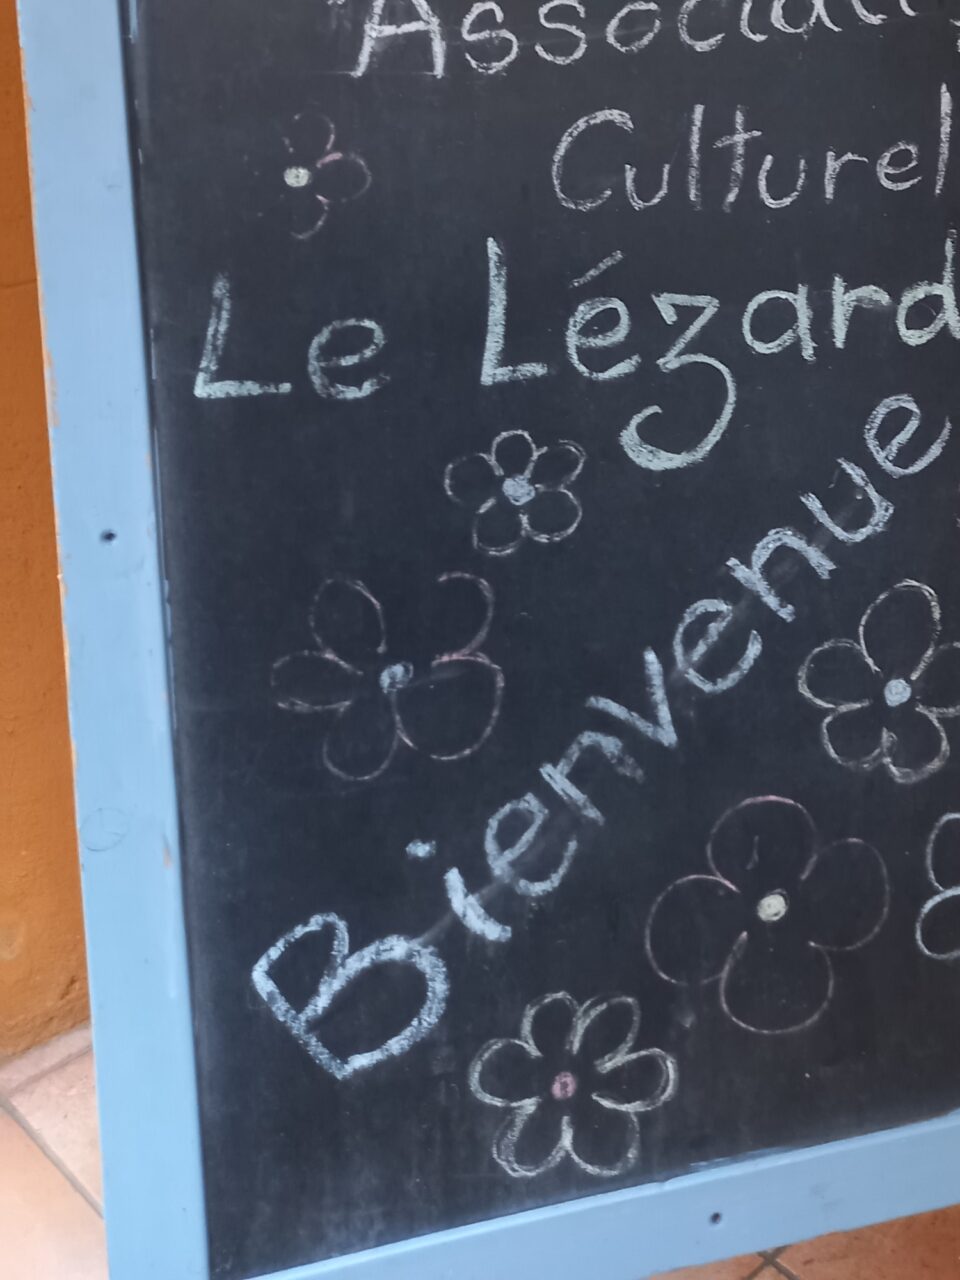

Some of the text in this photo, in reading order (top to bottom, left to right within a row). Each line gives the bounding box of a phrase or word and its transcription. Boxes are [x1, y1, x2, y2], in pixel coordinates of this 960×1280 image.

[550, 83, 954, 214] Culturel
[194, 272, 391, 400] Le
[252, 392, 951, 1079] Bienvenue
